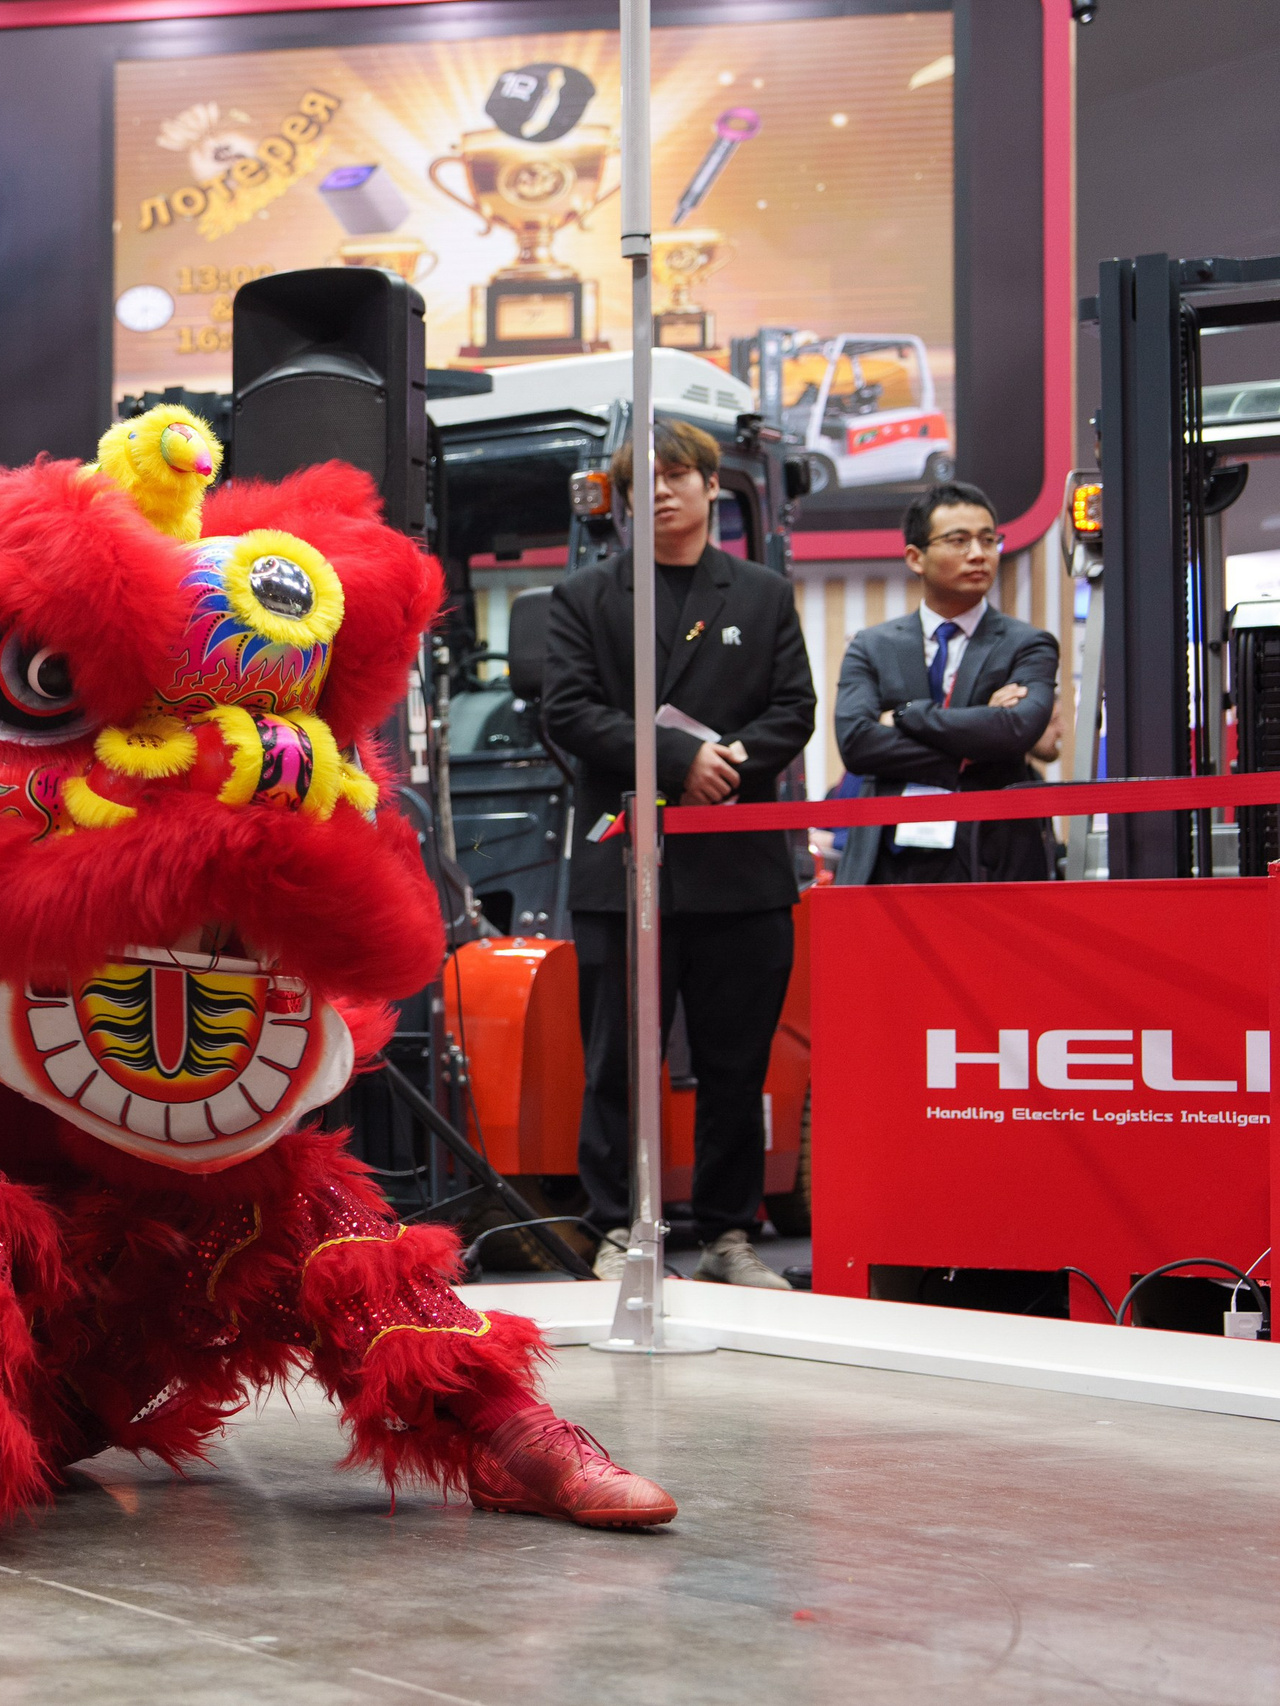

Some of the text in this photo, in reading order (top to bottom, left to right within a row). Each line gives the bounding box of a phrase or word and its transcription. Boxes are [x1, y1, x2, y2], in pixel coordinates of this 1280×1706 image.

[926, 1028, 1271, 1092] HELI
[926, 1105, 1271, 1128] Handling Electric Logistics Intelligen
